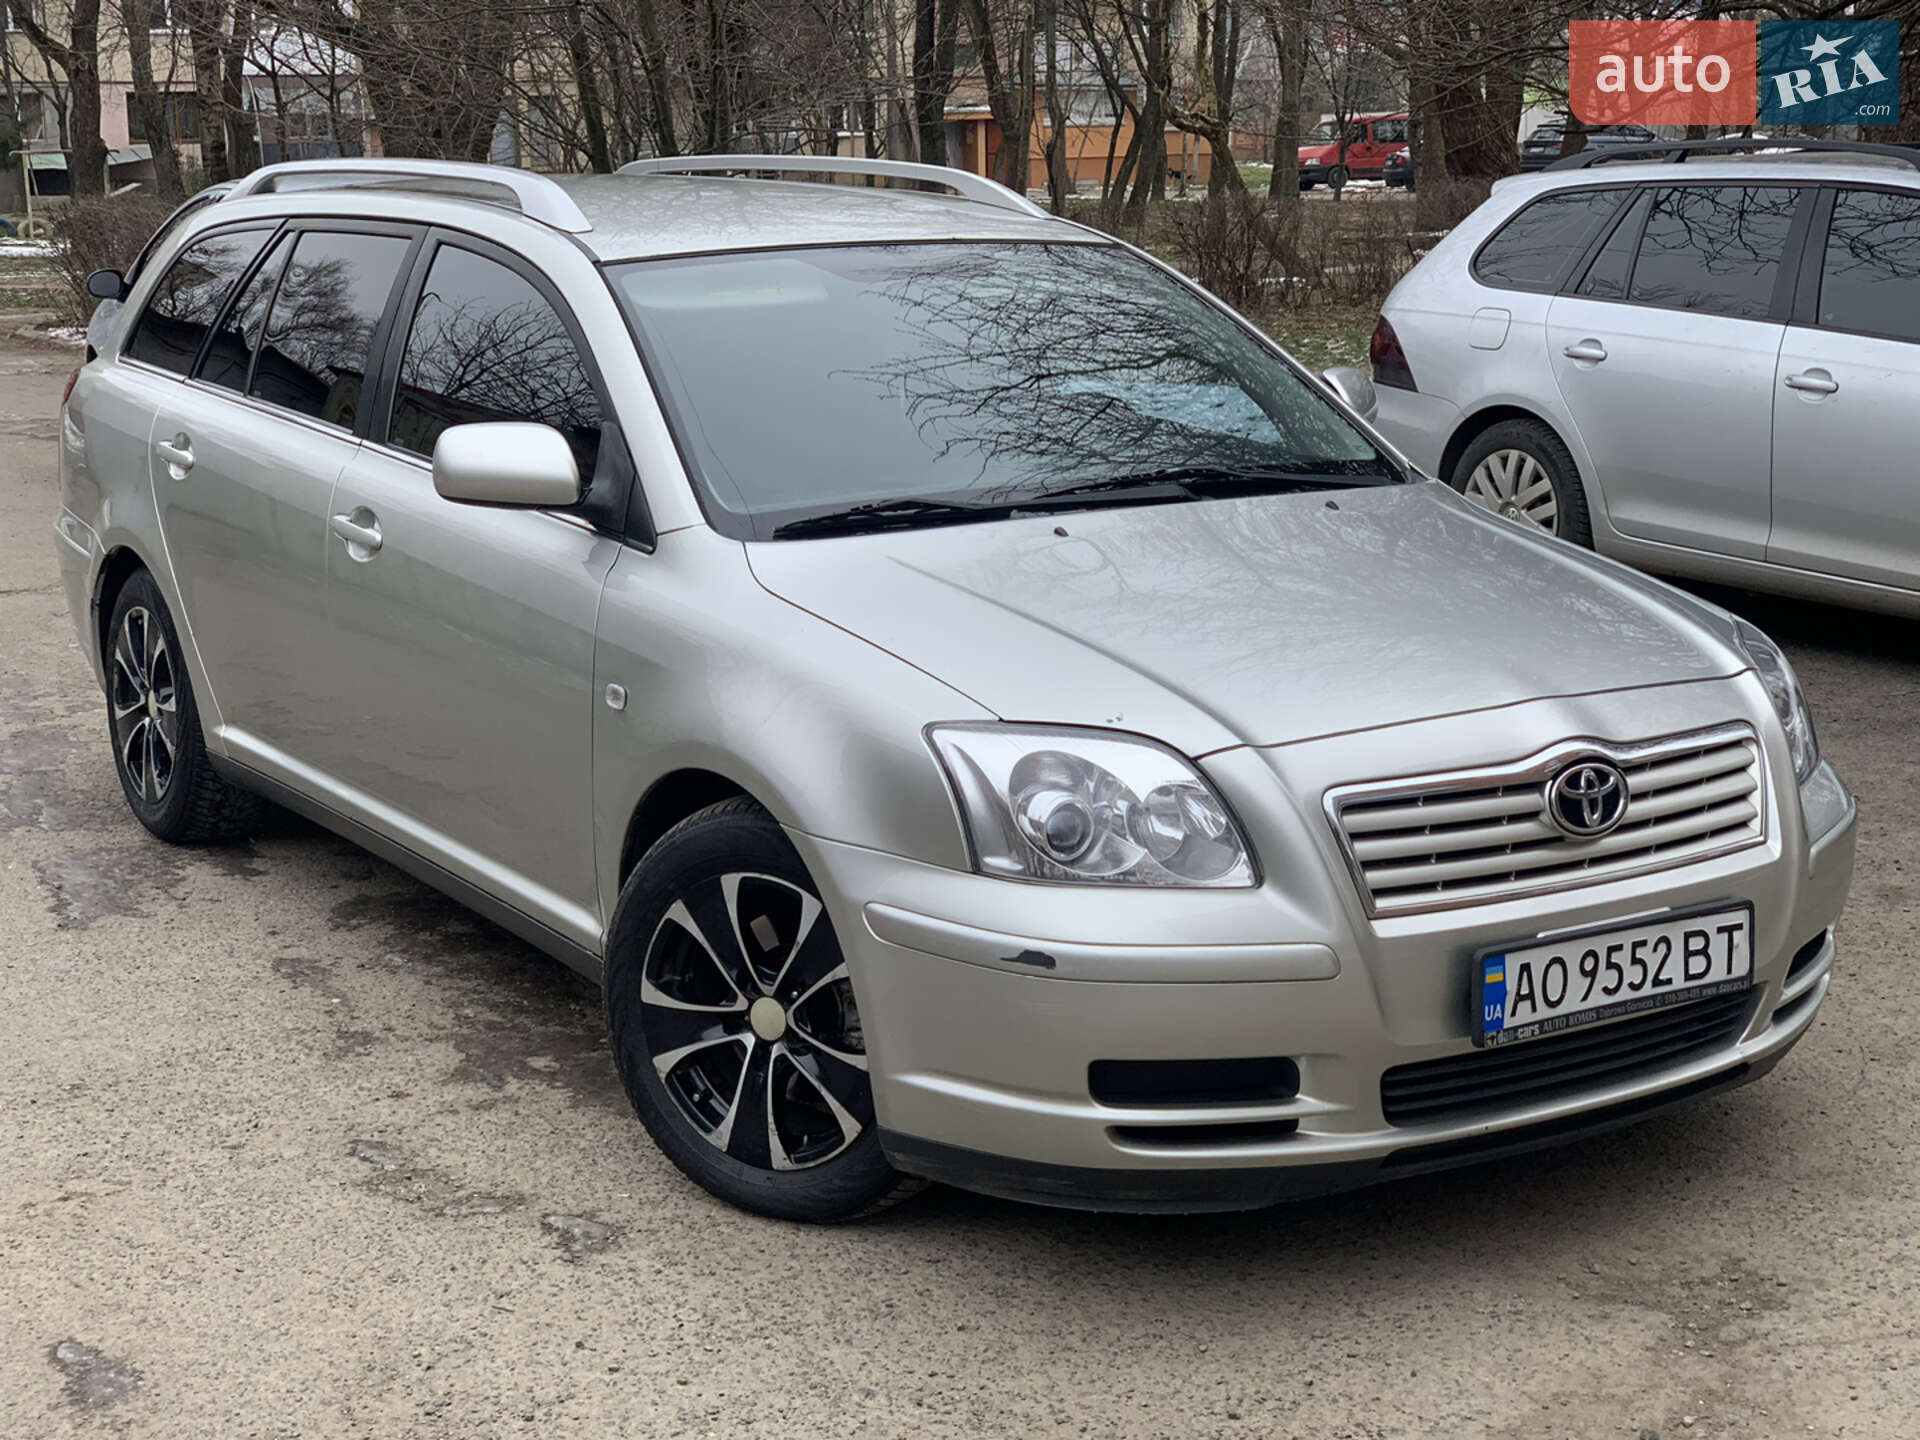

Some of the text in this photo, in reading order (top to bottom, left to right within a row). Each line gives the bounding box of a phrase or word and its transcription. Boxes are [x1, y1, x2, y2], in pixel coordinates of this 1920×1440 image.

[1510, 923, 1744, 1018] AO 9552 BT
[1484, 1003, 1503, 1021] UA
[1543, 1018, 1567, 1033] AUTO
